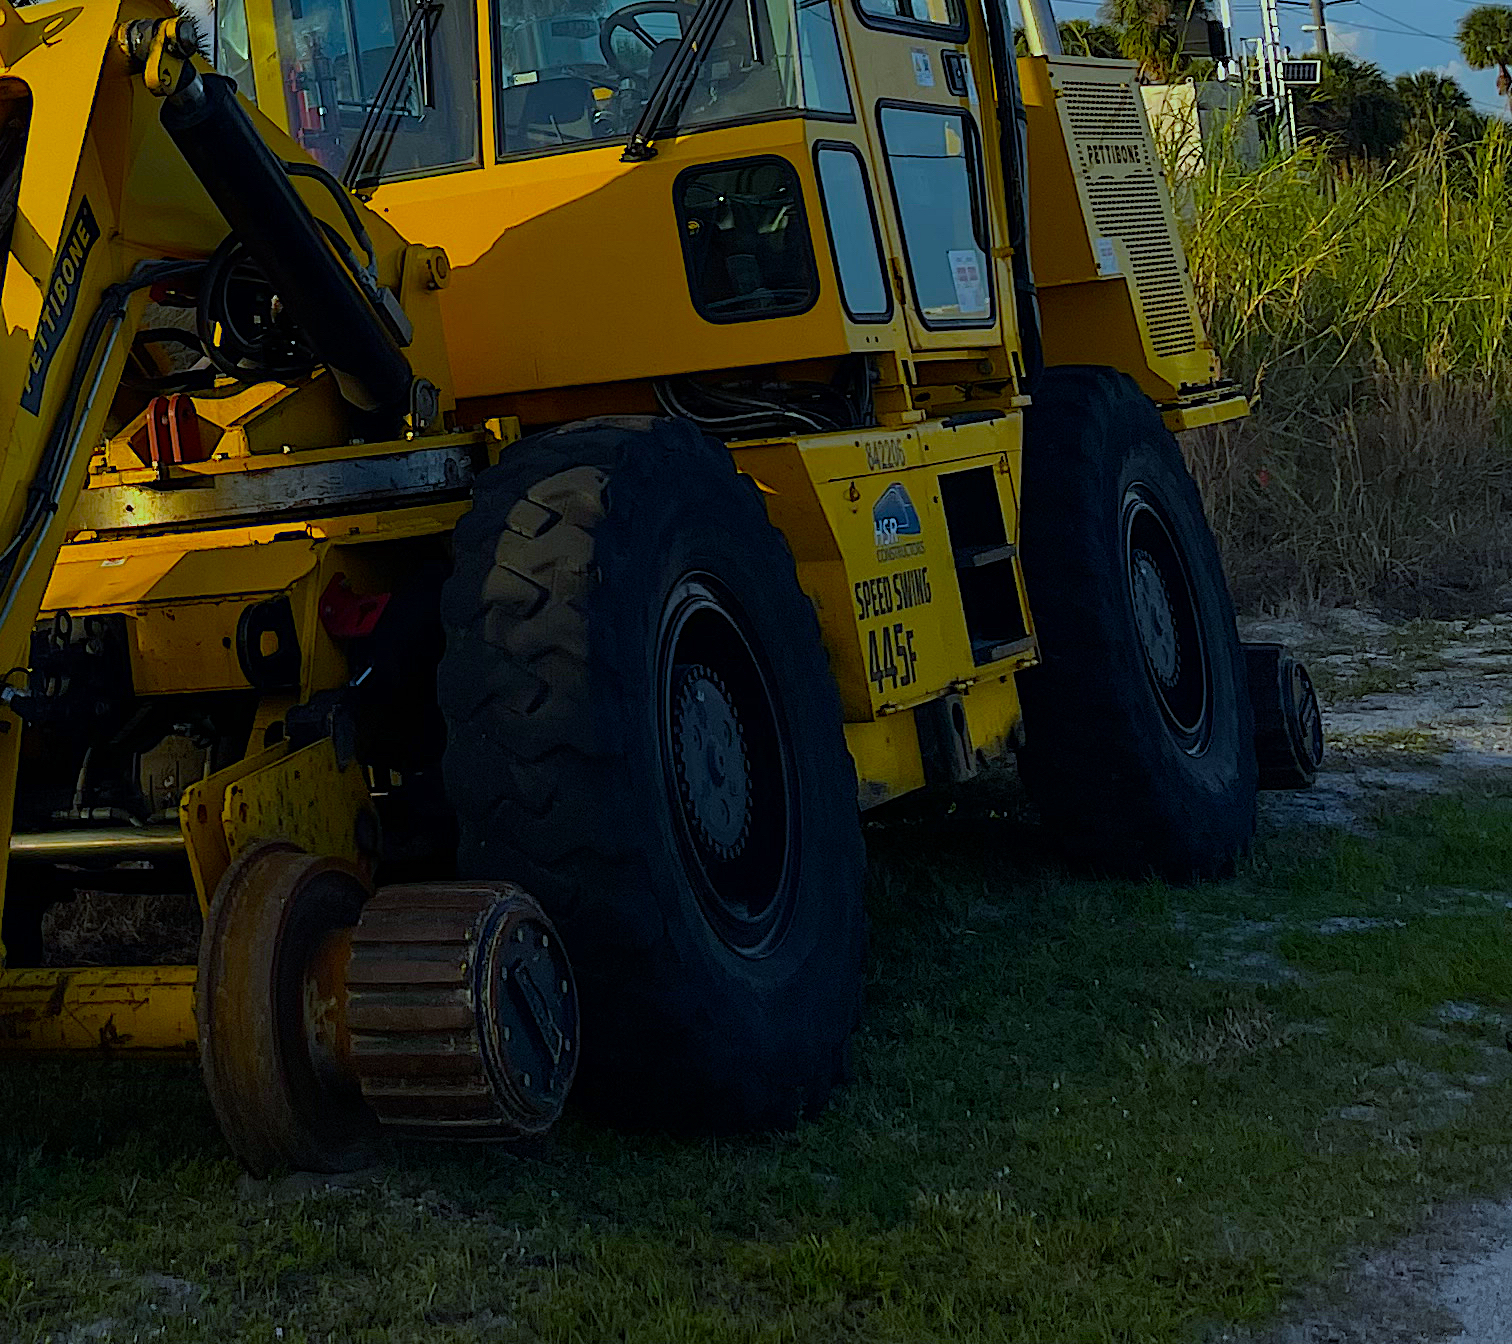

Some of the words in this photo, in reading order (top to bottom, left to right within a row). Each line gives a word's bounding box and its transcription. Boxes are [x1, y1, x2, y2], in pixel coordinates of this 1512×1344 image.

[1087, 144, 1141, 164] PETTIBONE
[874, 517, 899, 547] HSR
[854, 576, 893, 621] SPEED
[893, 567, 932, 611] SWING
[869, 623, 917, 694] 445F
